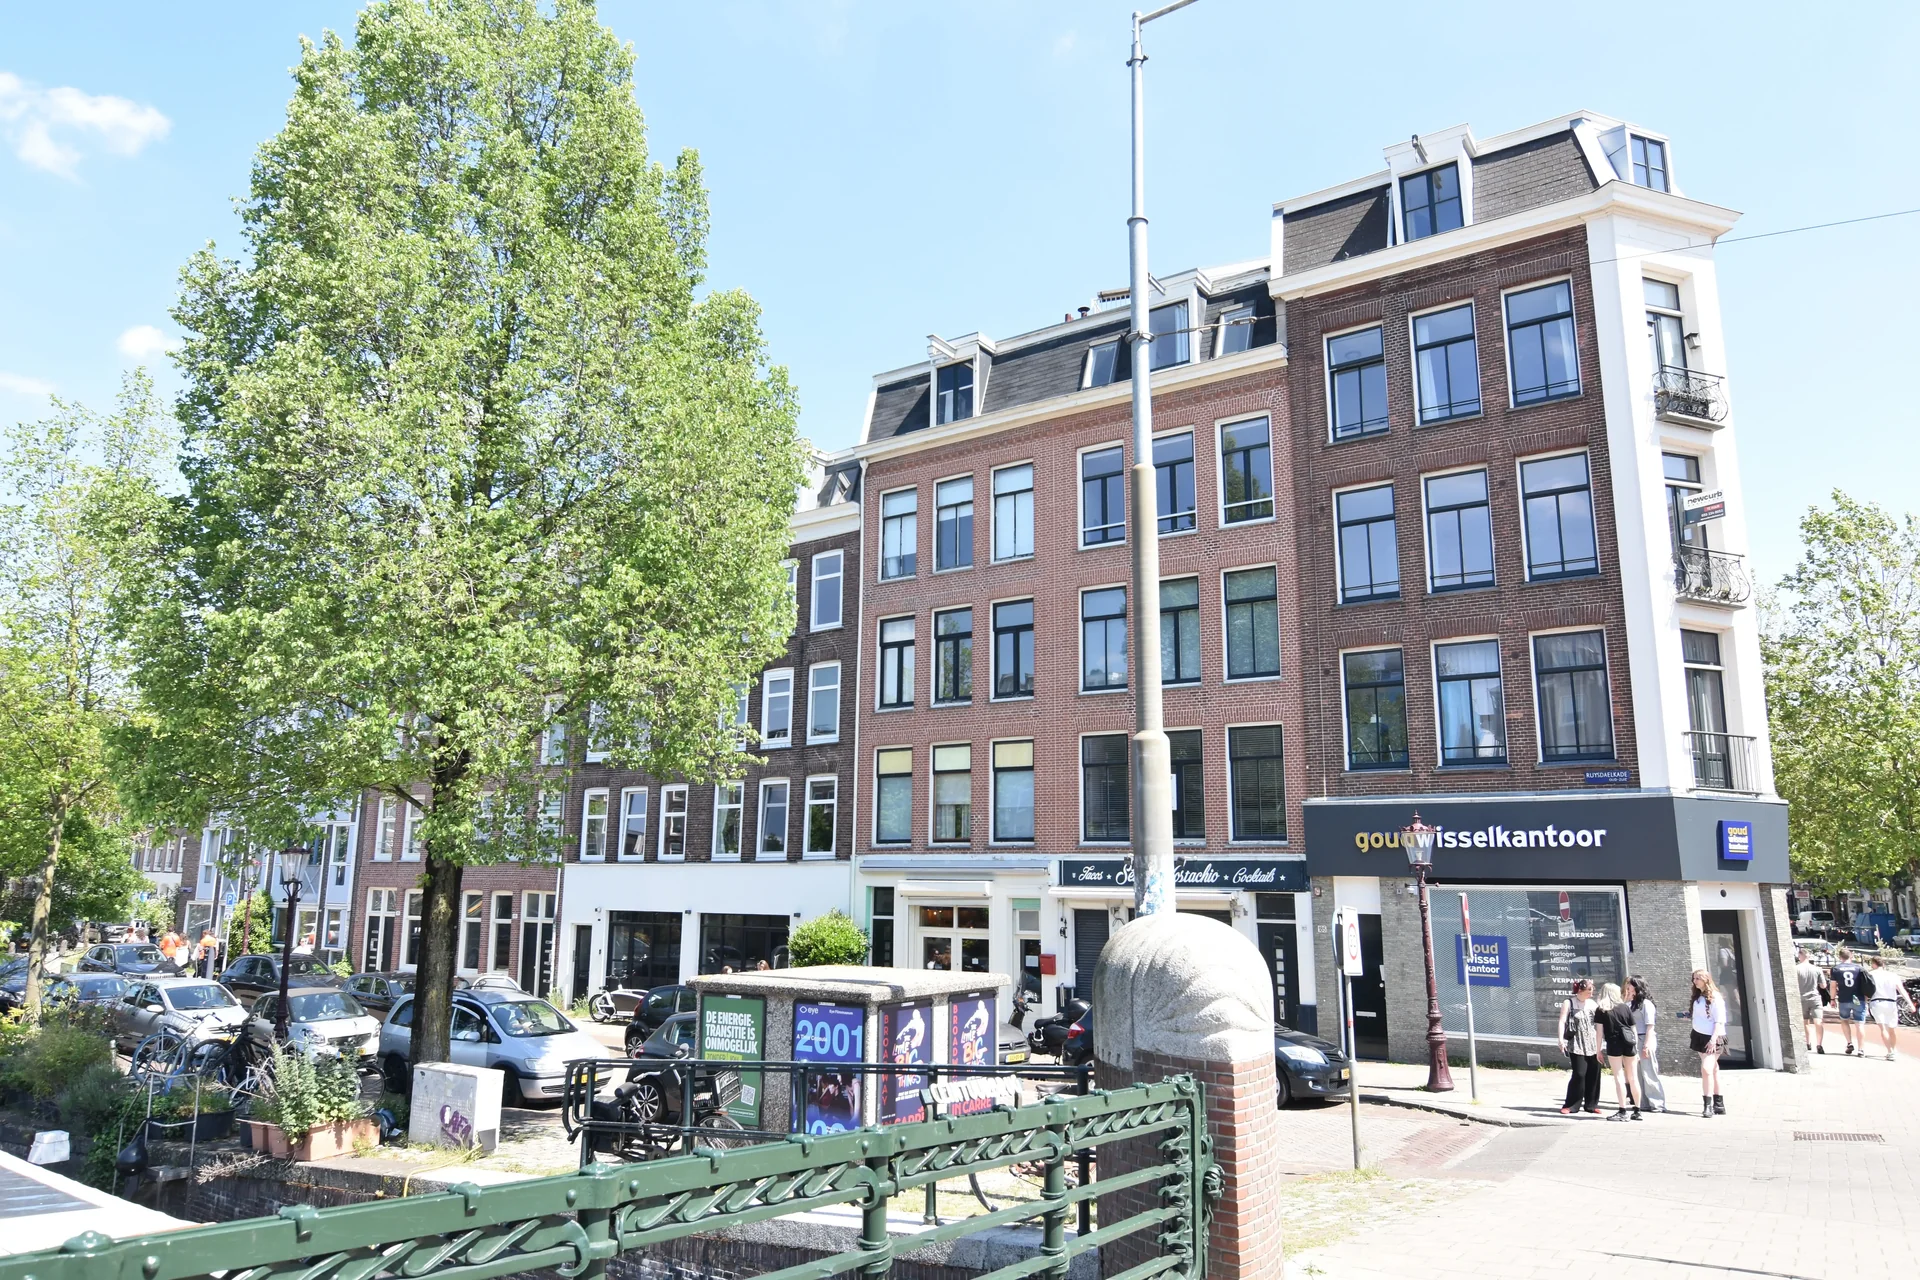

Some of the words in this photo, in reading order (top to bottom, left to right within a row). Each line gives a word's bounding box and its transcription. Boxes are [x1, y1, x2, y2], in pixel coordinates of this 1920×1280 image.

[1585, 771, 1628, 779] RUYSDAELKADE
[1727, 826, 1748, 837] goud
[1078, 865, 1104, 881] Tacos
[1174, 863, 1220, 883] ostachio
[1232, 867, 1277, 884] Cocktails
[1472, 942, 1499, 954] oud
[1843, 971, 1854, 988] 8
[705, 1010, 717, 1024] DE
[718, 1011, 755, 1027] ENERGIE-
[807, 1007, 819, 1015] eye
[705, 1024, 746, 1040] TRANSITIE
[747, 1027, 756, 1041] IS
[796, 1019, 863, 1059] 2001
[705, 1036, 758, 1054] ONMOGELIJK
[963, 1037, 988, 1064] BIG
